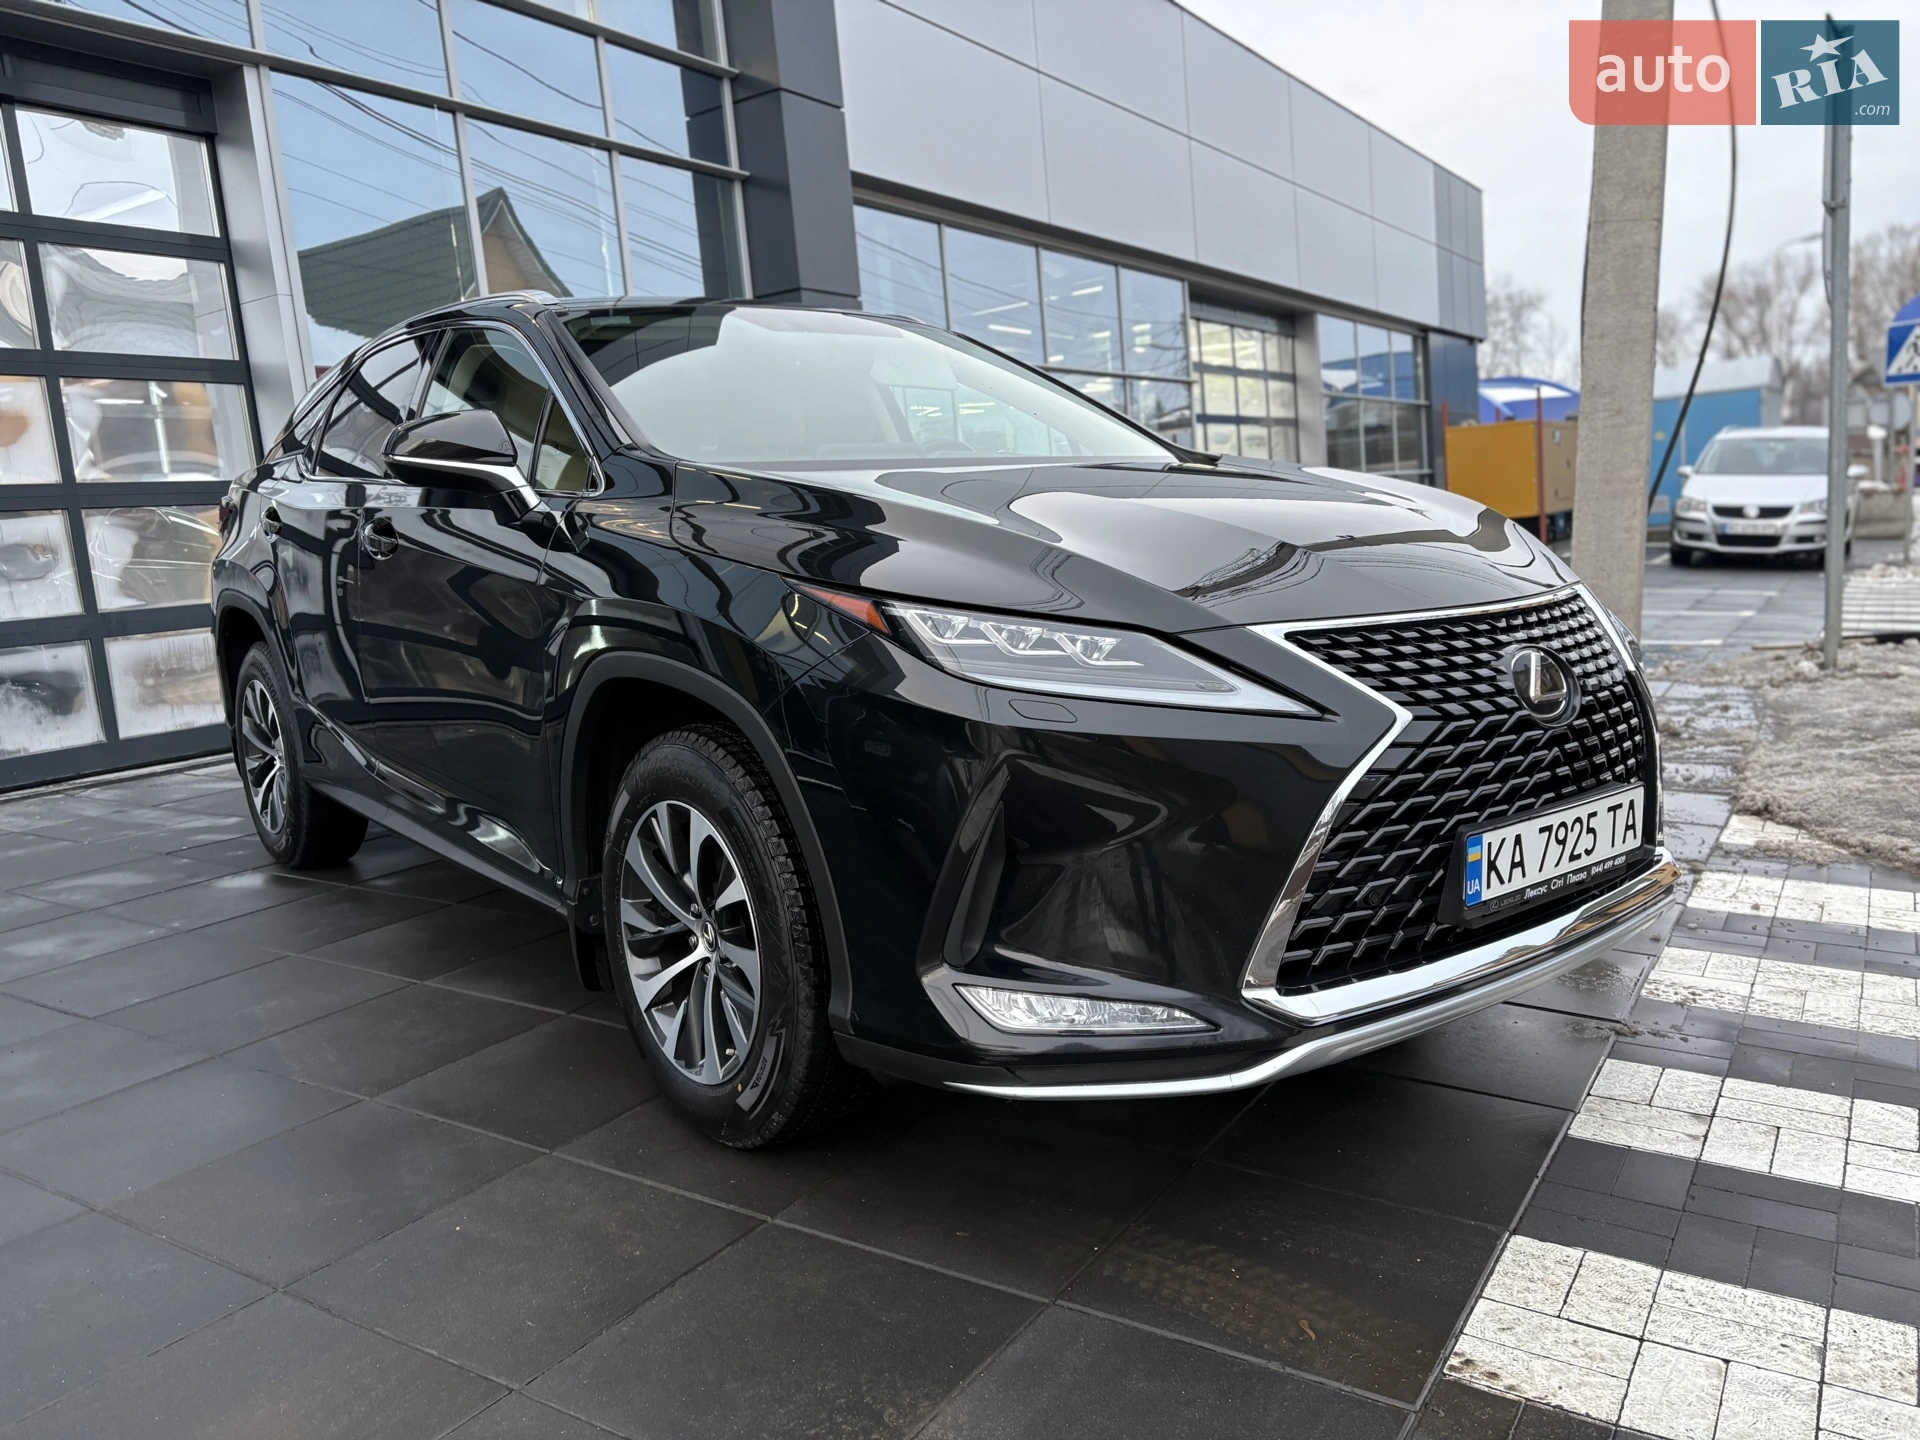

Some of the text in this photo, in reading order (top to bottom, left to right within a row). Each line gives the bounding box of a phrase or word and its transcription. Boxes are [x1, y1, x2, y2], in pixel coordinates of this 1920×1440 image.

[1486, 799, 1637, 890] KA 7925 TA
[1467, 878, 1480, 895] UA
[1523, 884, 1548, 900] Лексус
[1566, 871, 1588, 885] Плаза
